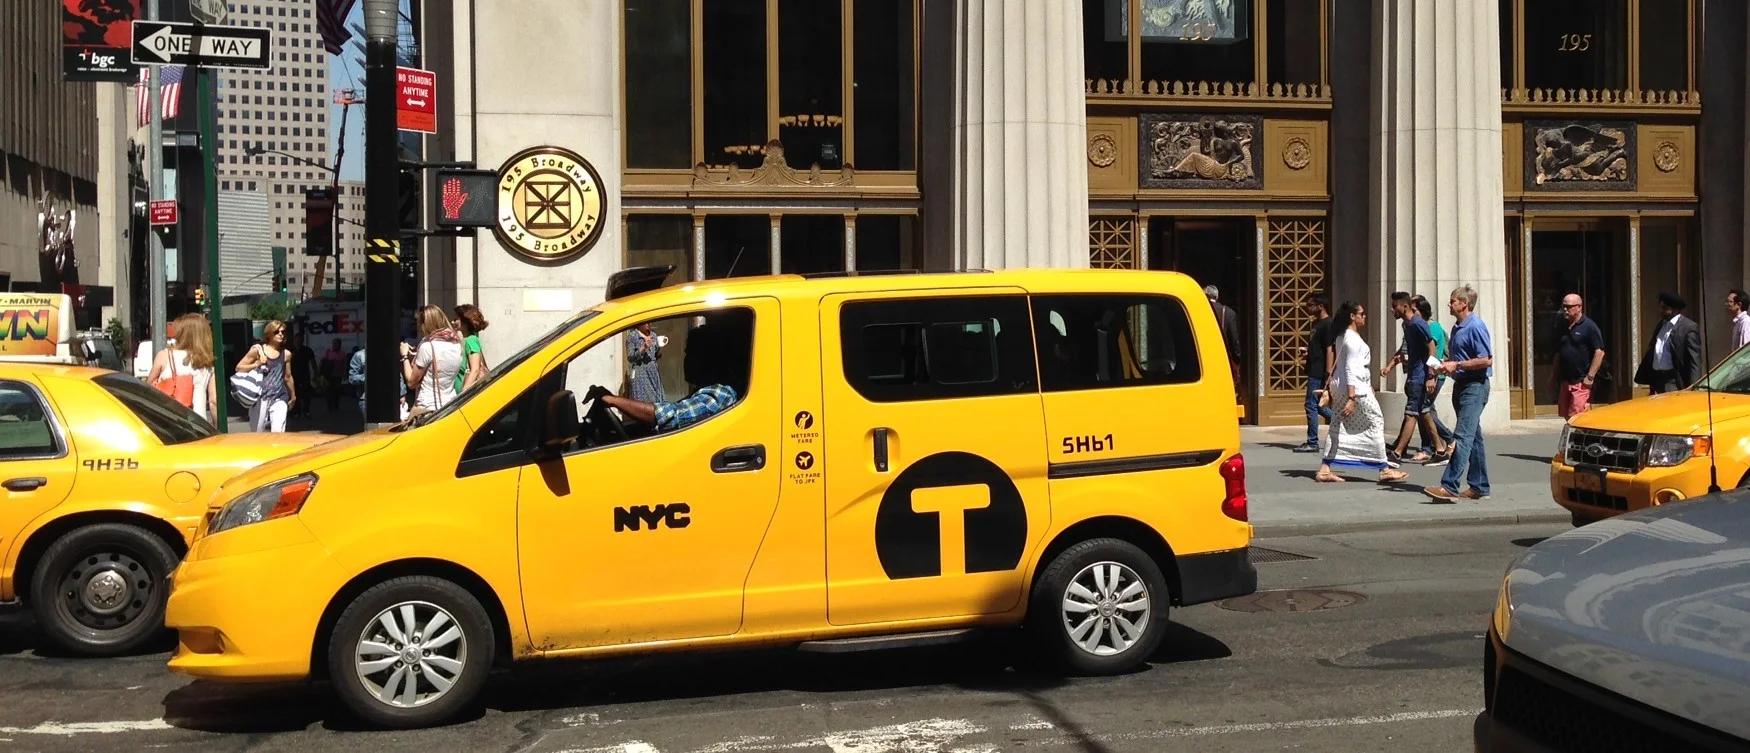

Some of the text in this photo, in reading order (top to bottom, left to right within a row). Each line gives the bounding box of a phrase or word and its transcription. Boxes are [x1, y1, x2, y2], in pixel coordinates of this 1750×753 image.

[154, 36, 252, 56] ONE WAY
[1558, 34, 1592, 51] 195
[91, 52, 115, 67] bgc
[398, 73, 432, 86] NO STANDING
[402, 86, 429, 97] ANYTIME
[502, 158, 592, 193] 195 Broadway
[502, 214, 596, 252] 195 Broadway
[9, 298, 51, 306] MARVIN
[299, 314, 364, 334] FedEx
[614, 503, 690, 532] NYC
[910, 483, 991, 577] T
